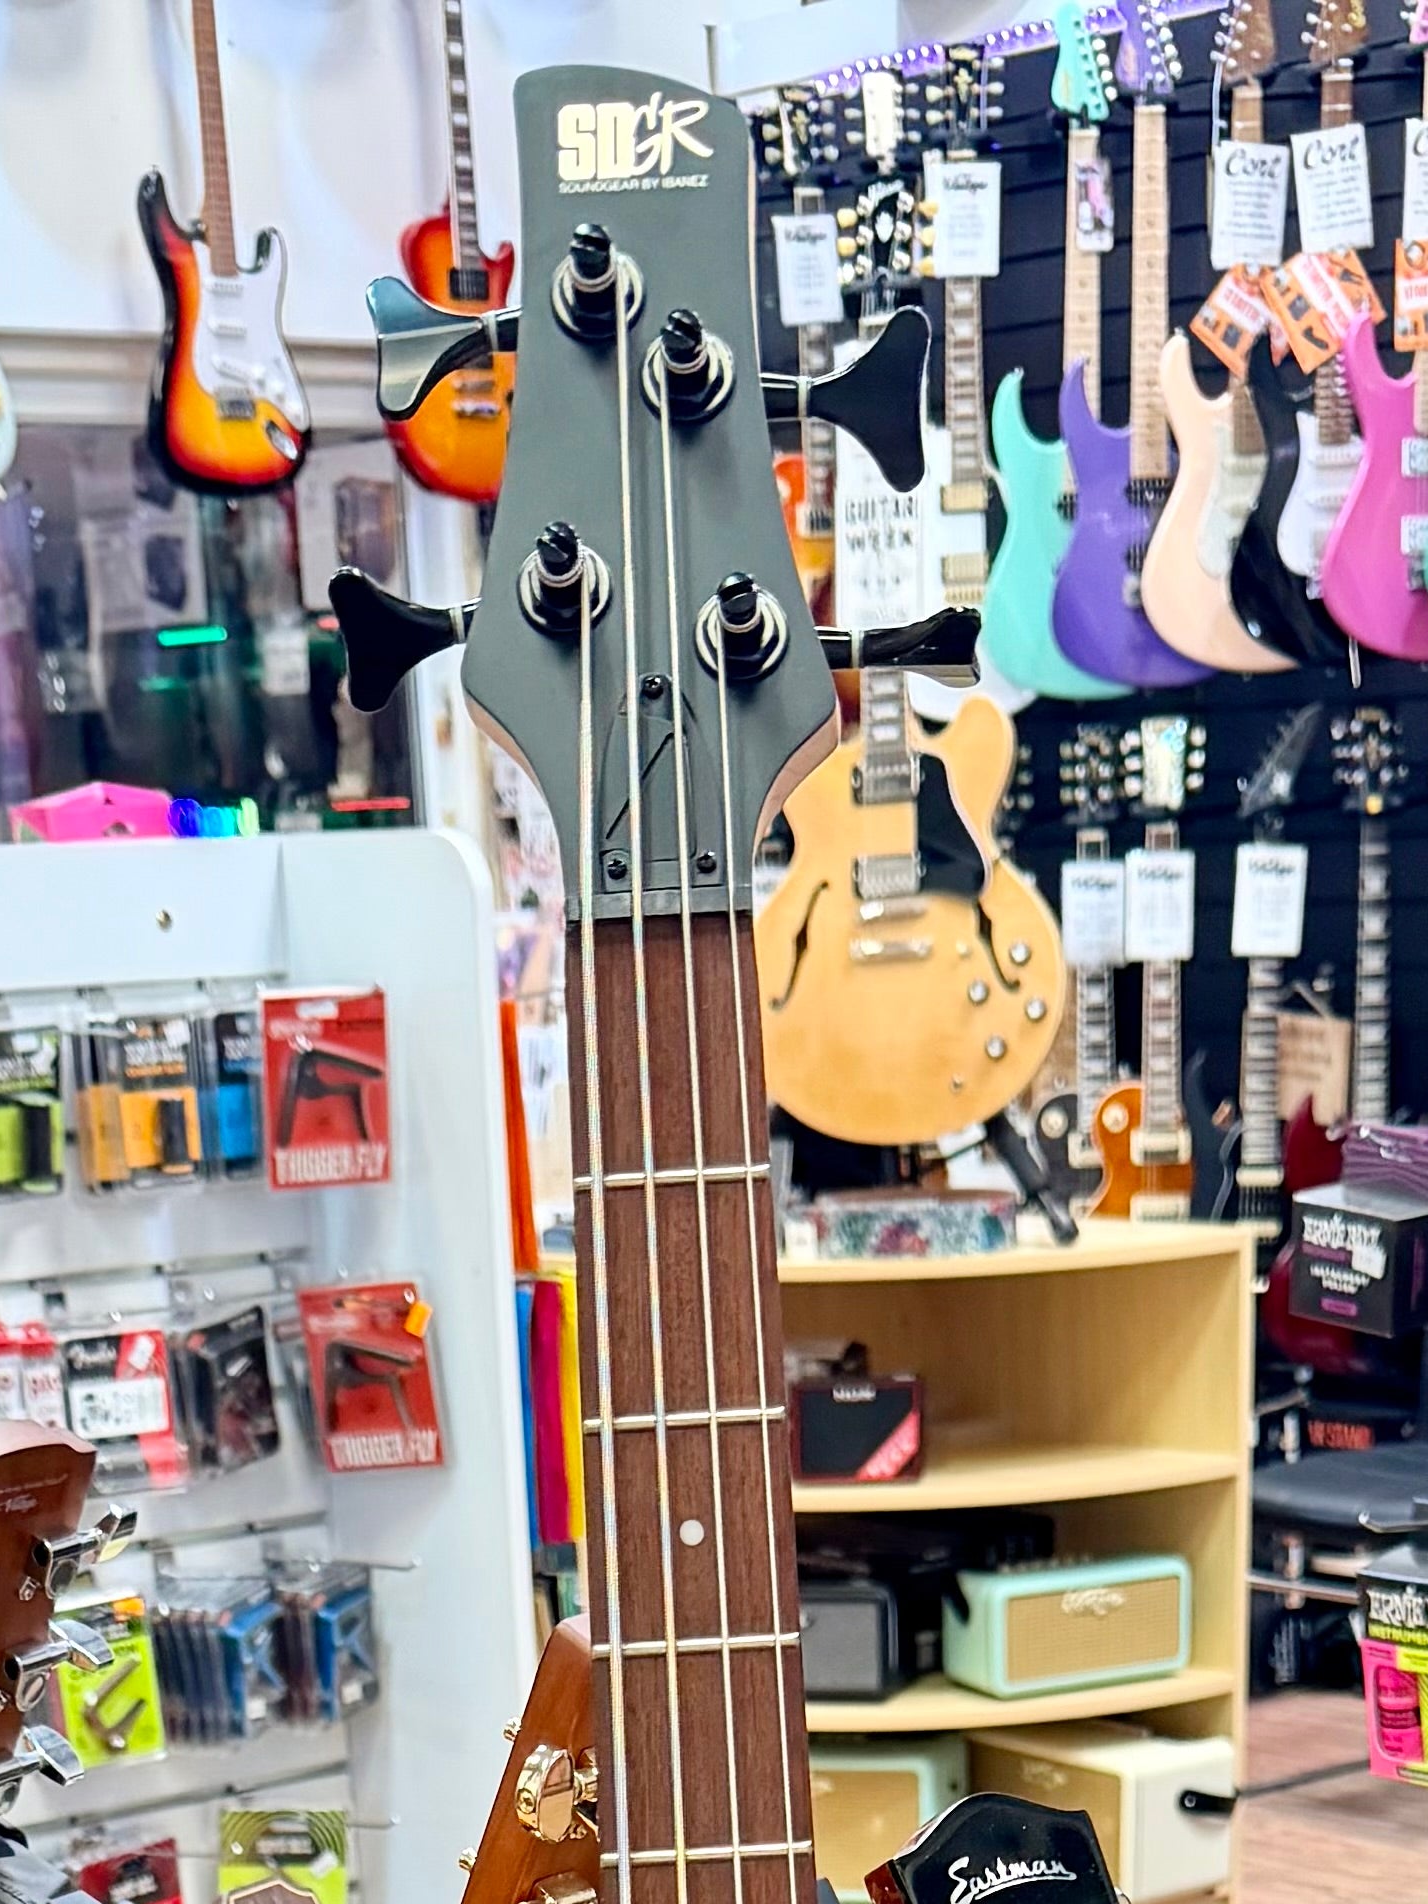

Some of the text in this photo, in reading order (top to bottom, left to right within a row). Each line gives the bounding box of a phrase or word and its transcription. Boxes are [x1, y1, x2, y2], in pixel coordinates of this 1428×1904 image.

[1225, 148, 1282, 180] Cort
[1303, 136, 1360, 171] Cort
[558, 174, 709, 195] SOUNDGEAR BY IBANEZ
[1366, 1585, 1426, 1630] ERNIE
